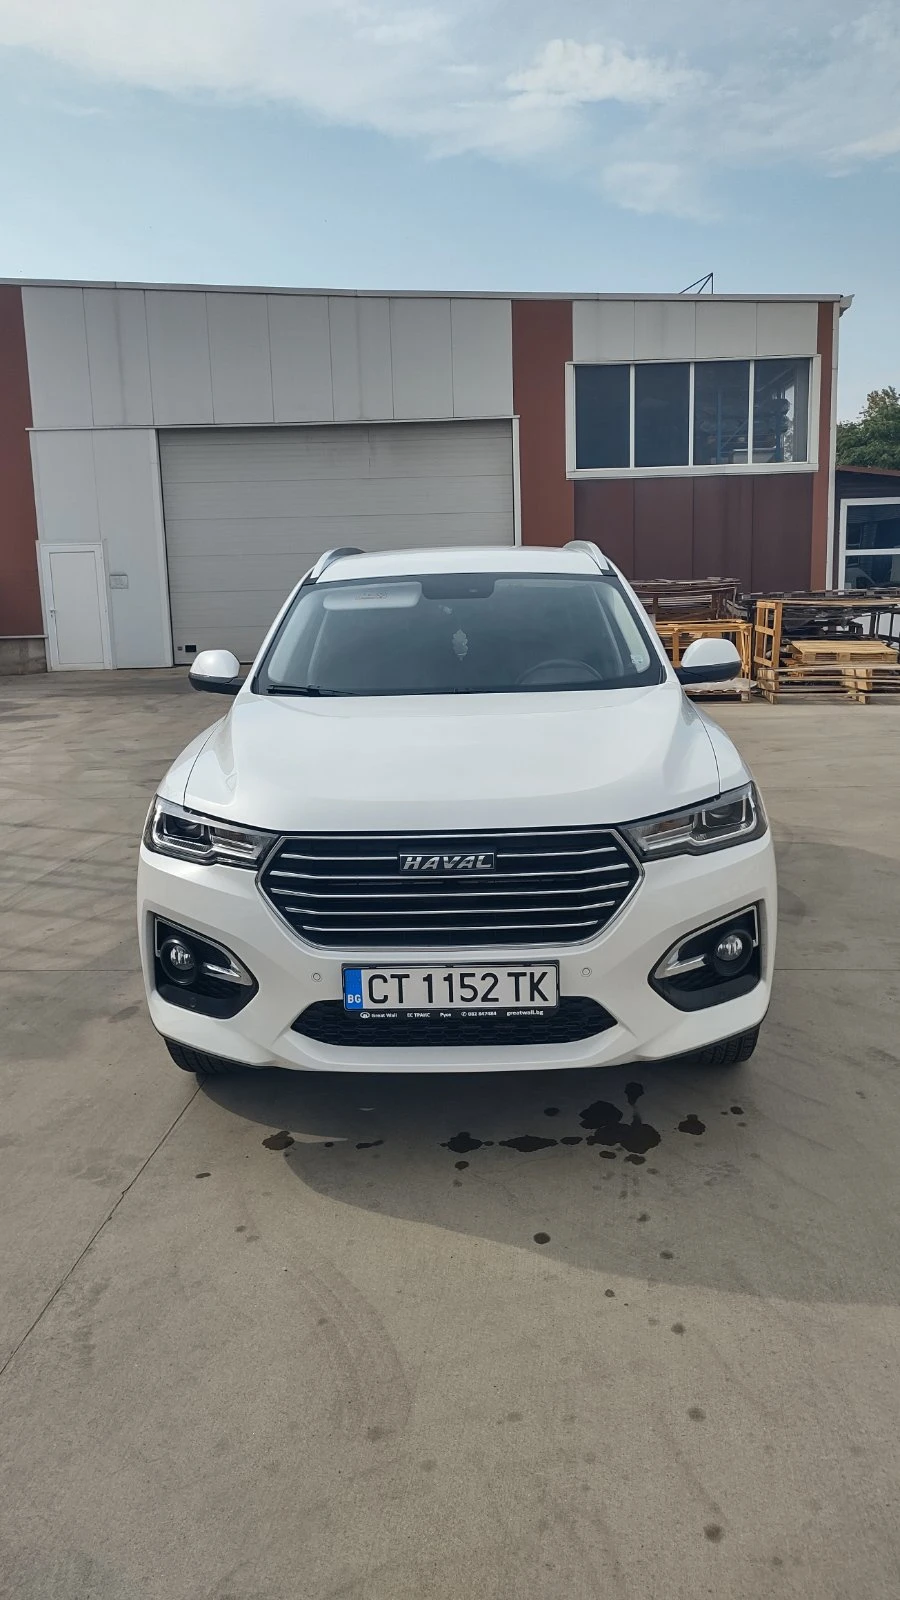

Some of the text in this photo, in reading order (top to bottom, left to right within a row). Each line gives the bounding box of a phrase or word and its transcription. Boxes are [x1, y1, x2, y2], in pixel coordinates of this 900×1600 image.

[403, 855, 492, 870] HAVAL
[367, 971, 549, 1004] CT 1152 TK
[347, 994, 362, 1004] BG
